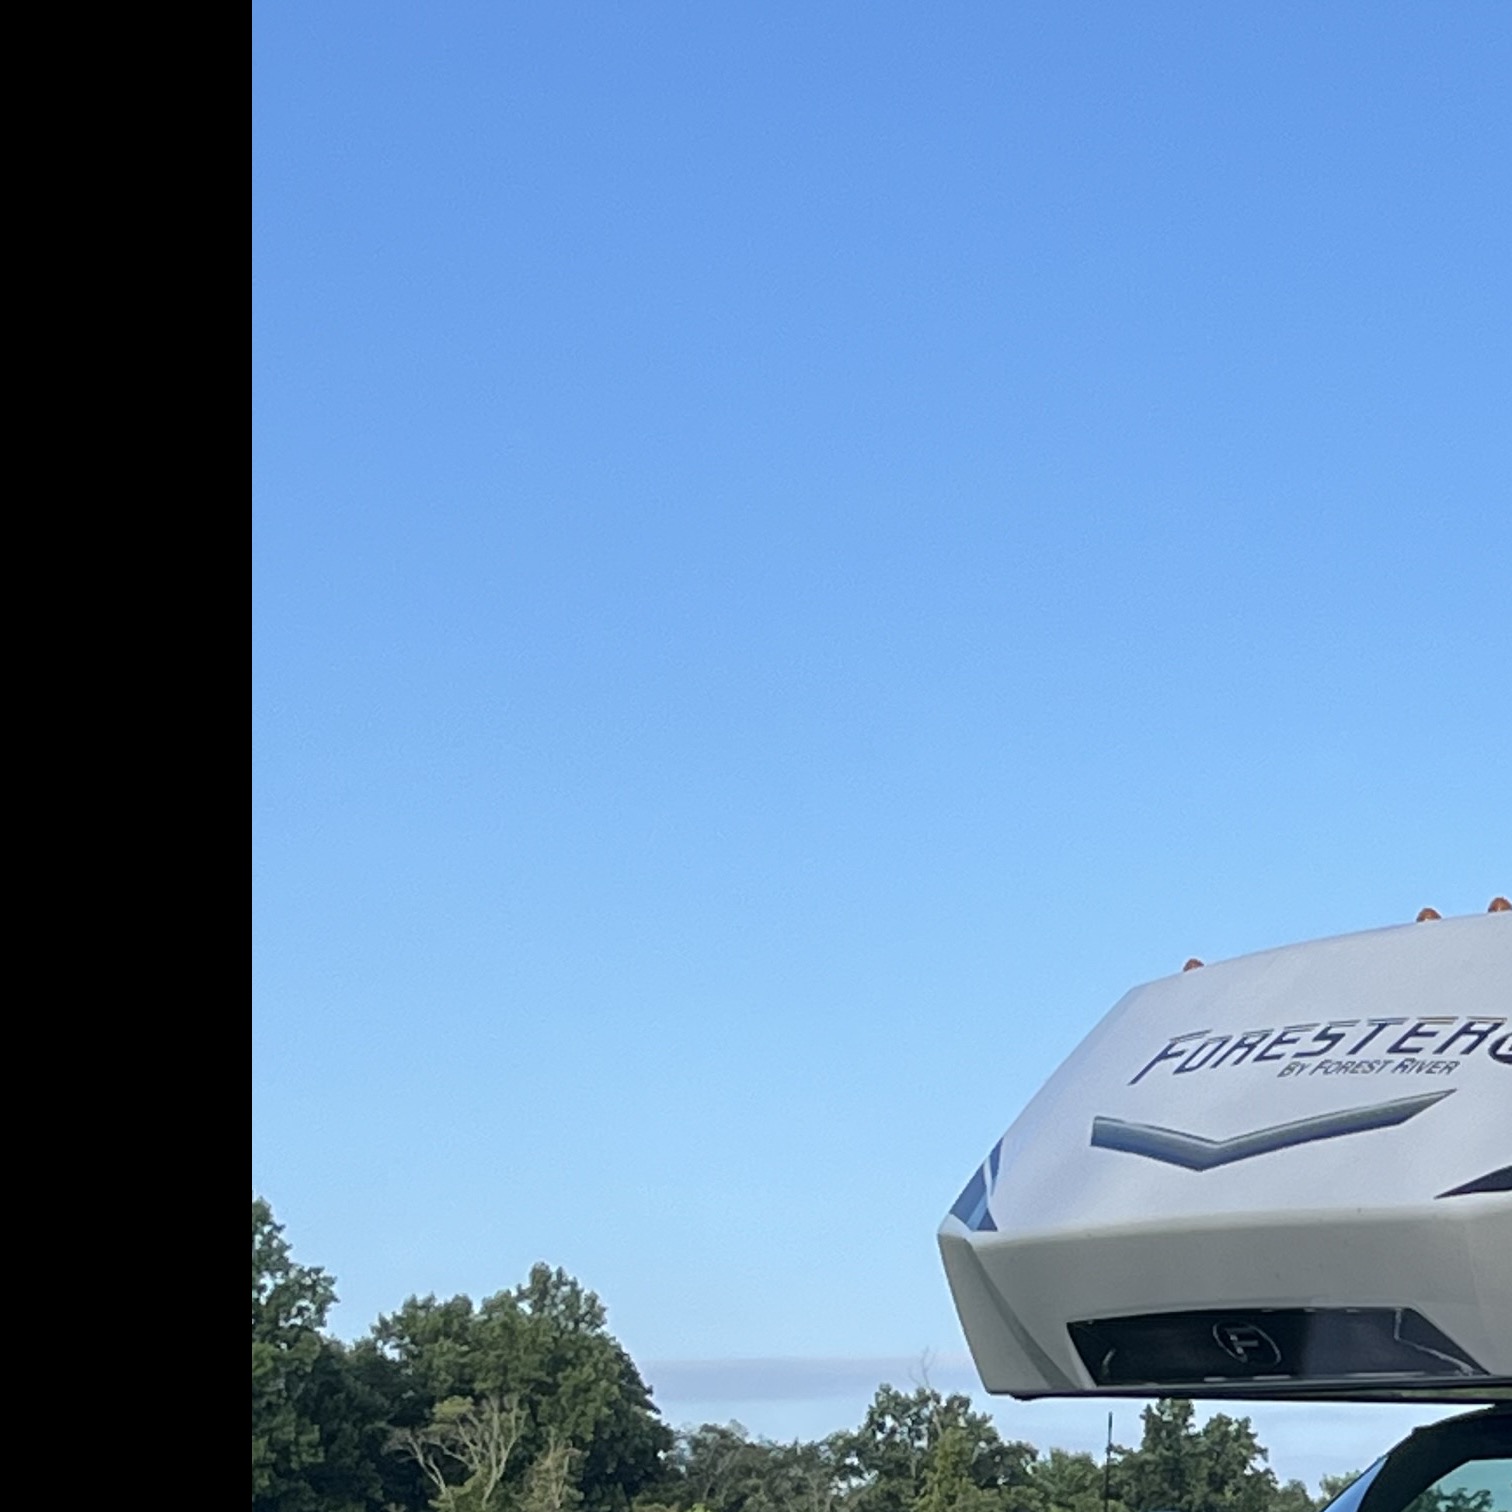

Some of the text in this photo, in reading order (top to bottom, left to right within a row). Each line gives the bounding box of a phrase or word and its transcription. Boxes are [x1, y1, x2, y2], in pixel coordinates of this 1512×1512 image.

[1127, 1016, 1508, 1086] FORESTER
[1276, 1057, 1461, 1078] BY FOREST RIVER
